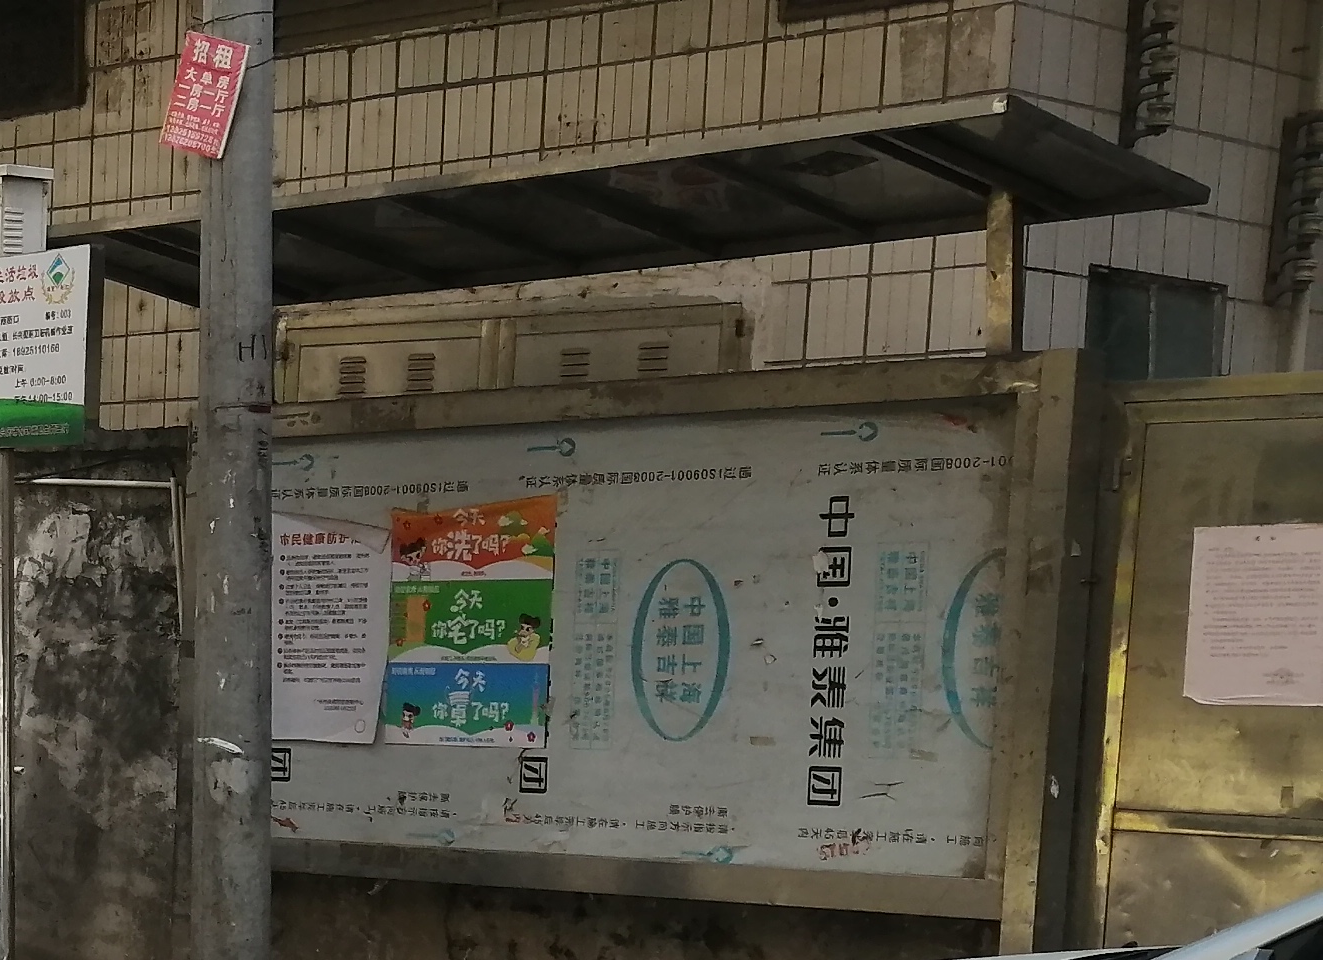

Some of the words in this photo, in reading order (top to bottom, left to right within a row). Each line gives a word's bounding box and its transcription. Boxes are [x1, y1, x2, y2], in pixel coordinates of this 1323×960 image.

[193, 38, 233, 69] 招租
[184, 67, 230, 90] 大单房
[178, 83, 228, 103] 一房一厅
[174, 95, 225, 117] 二房一厅
[453, 508, 486, 526] 今天
[450, 588, 483, 612] 今天
[431, 613, 505, 645] 你宅了吗?
[680, 596, 706, 704] 中国上海
[807, 495, 855, 808] 中国·雅泰集团
[455, 668, 487, 692] 今天
